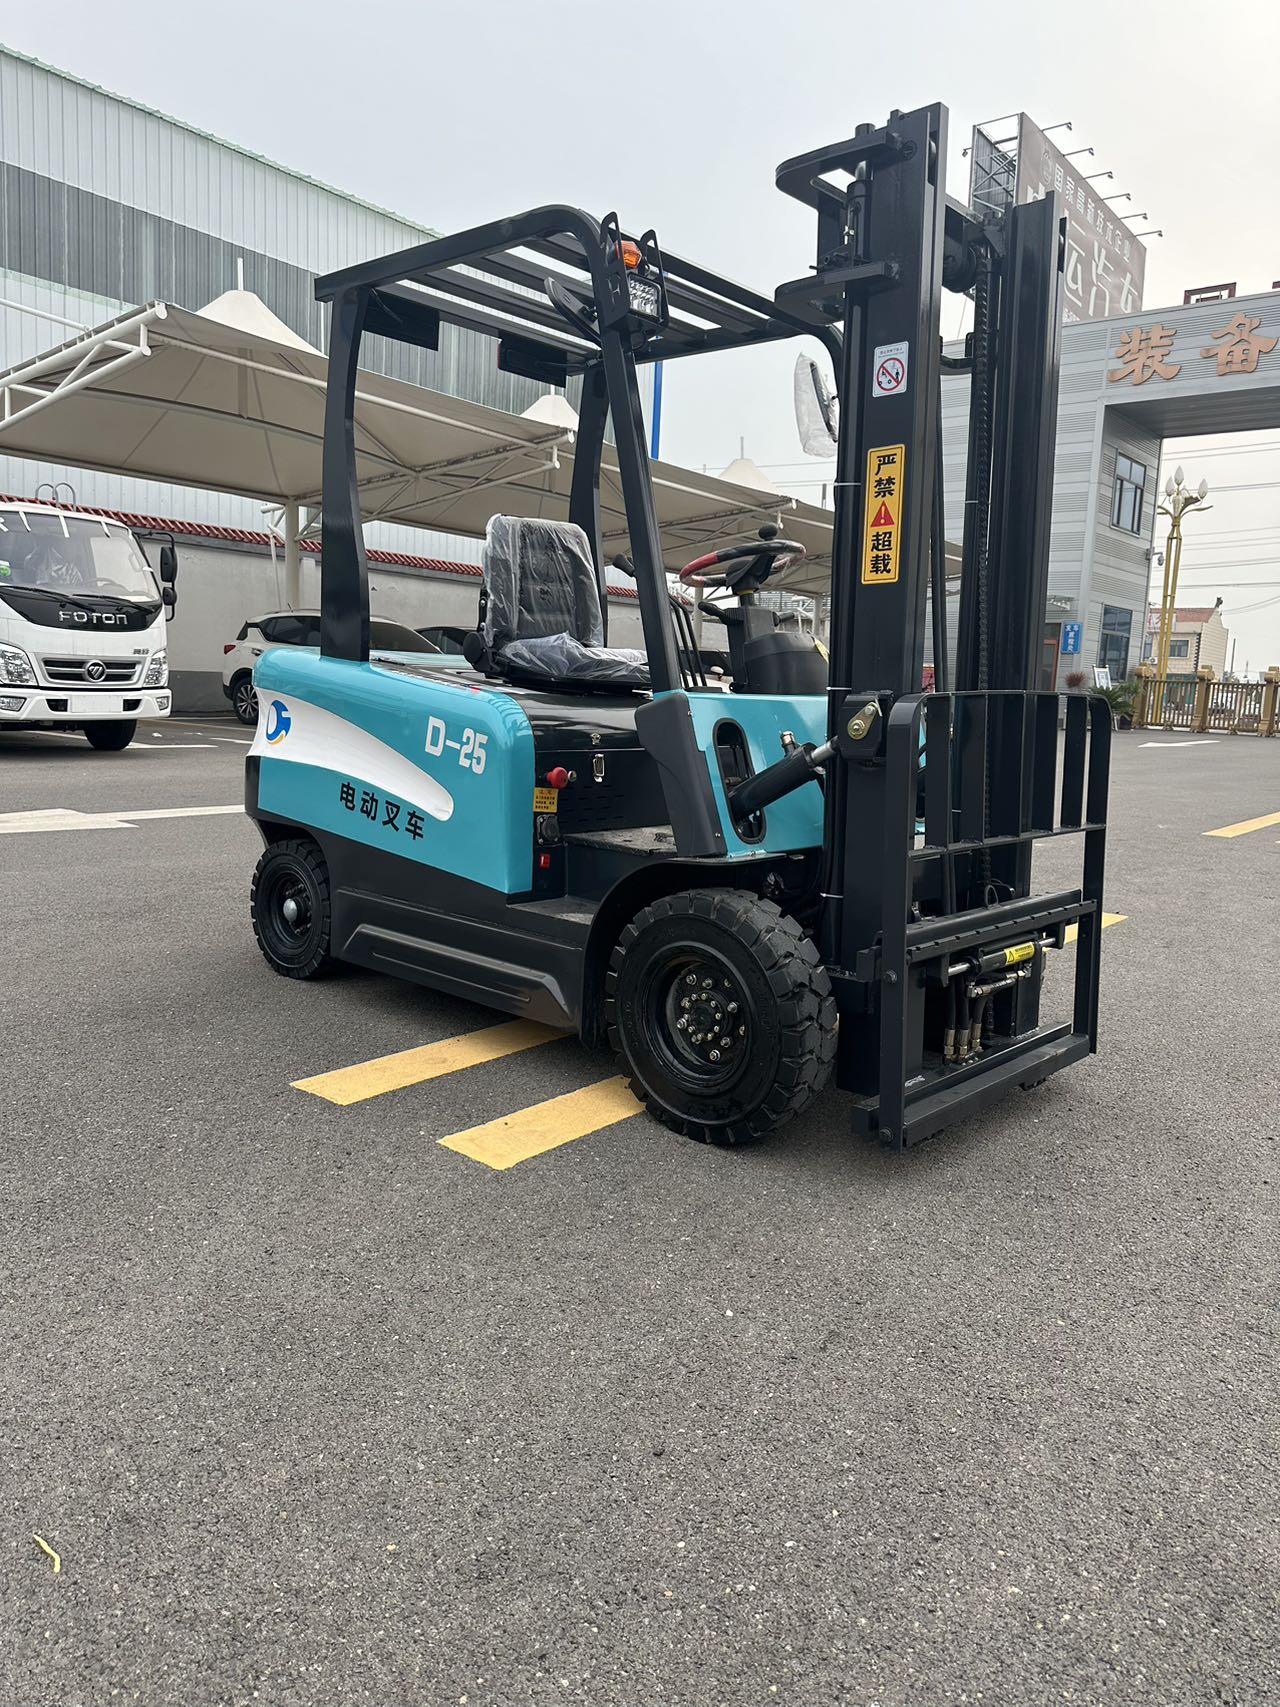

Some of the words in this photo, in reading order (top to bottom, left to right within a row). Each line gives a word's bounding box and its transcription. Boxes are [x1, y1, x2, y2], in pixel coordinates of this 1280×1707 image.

[1107, 311, 1280, 386] 装备
[874, 453, 898, 498] 严禁
[869, 531, 893, 575] 超载
[425, 715, 488, 775] D-25
[339, 782, 425, 840] 电动叉车
